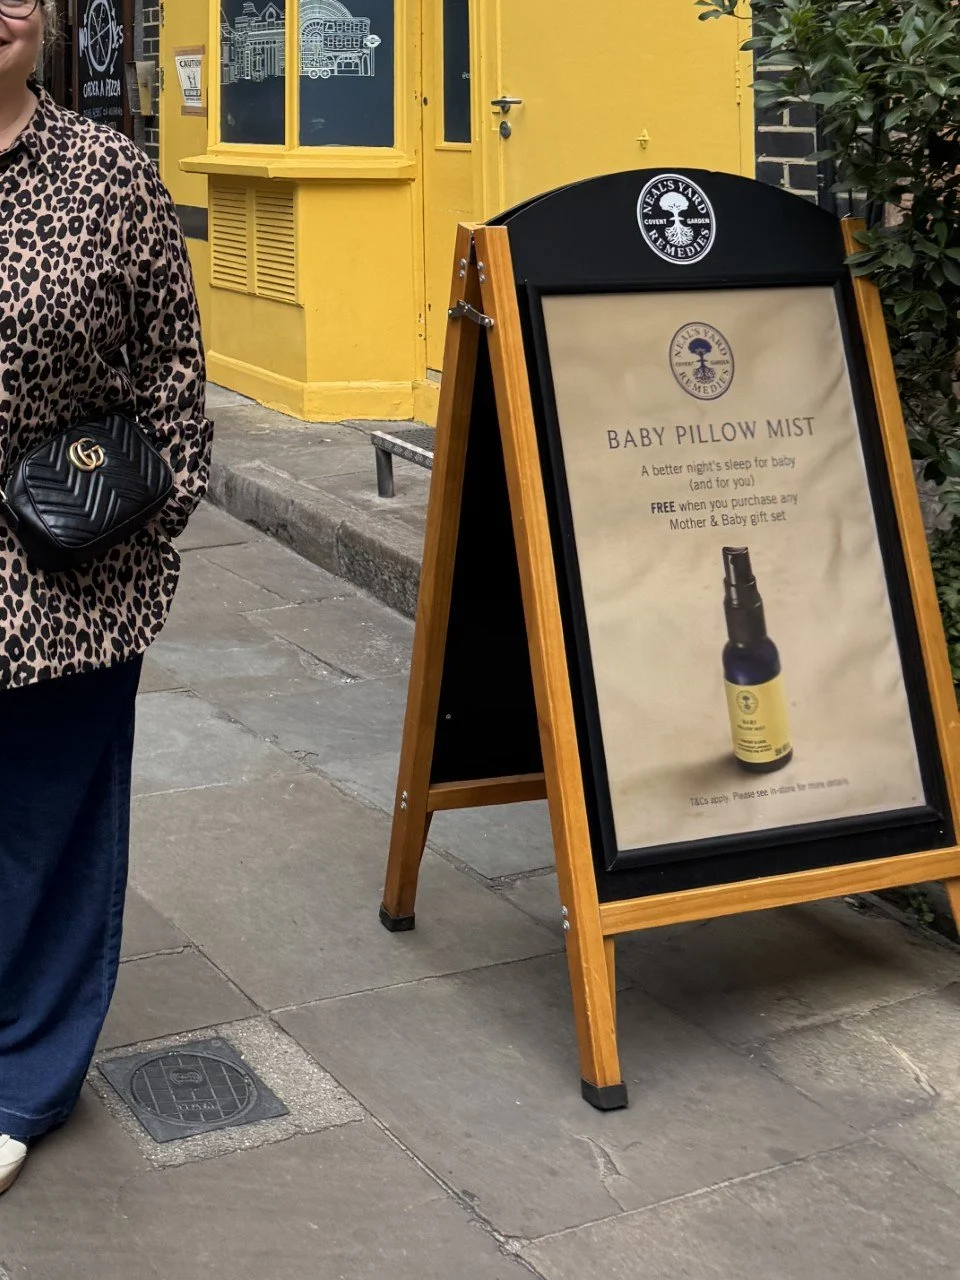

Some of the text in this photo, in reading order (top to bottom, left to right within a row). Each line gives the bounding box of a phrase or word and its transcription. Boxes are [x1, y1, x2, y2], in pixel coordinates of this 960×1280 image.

[100, 80, 105, 97] A
[105, 79, 121, 97] PIZZA
[643, 180, 707, 215] NEAL'S YARD
[649, 228, 710, 257] REMEDIES
[703, 328, 728, 356] YARD
[679, 368, 729, 394] REMEDIES
[607, 416, 815, 449] BABY PILLOW MIST
[641, 455, 796, 477] A better night's sleep for baby
[690, 474, 755, 492] (and for you)
[651, 493, 799, 514] FREE when you purchase any
[670, 510, 787, 531] Mother & Baby gift set
[690, 797, 709, 807] T&Cs
[710, 794, 731, 805] apply.
[733, 790, 755, 801] Please
[756, 789, 769, 797] see
